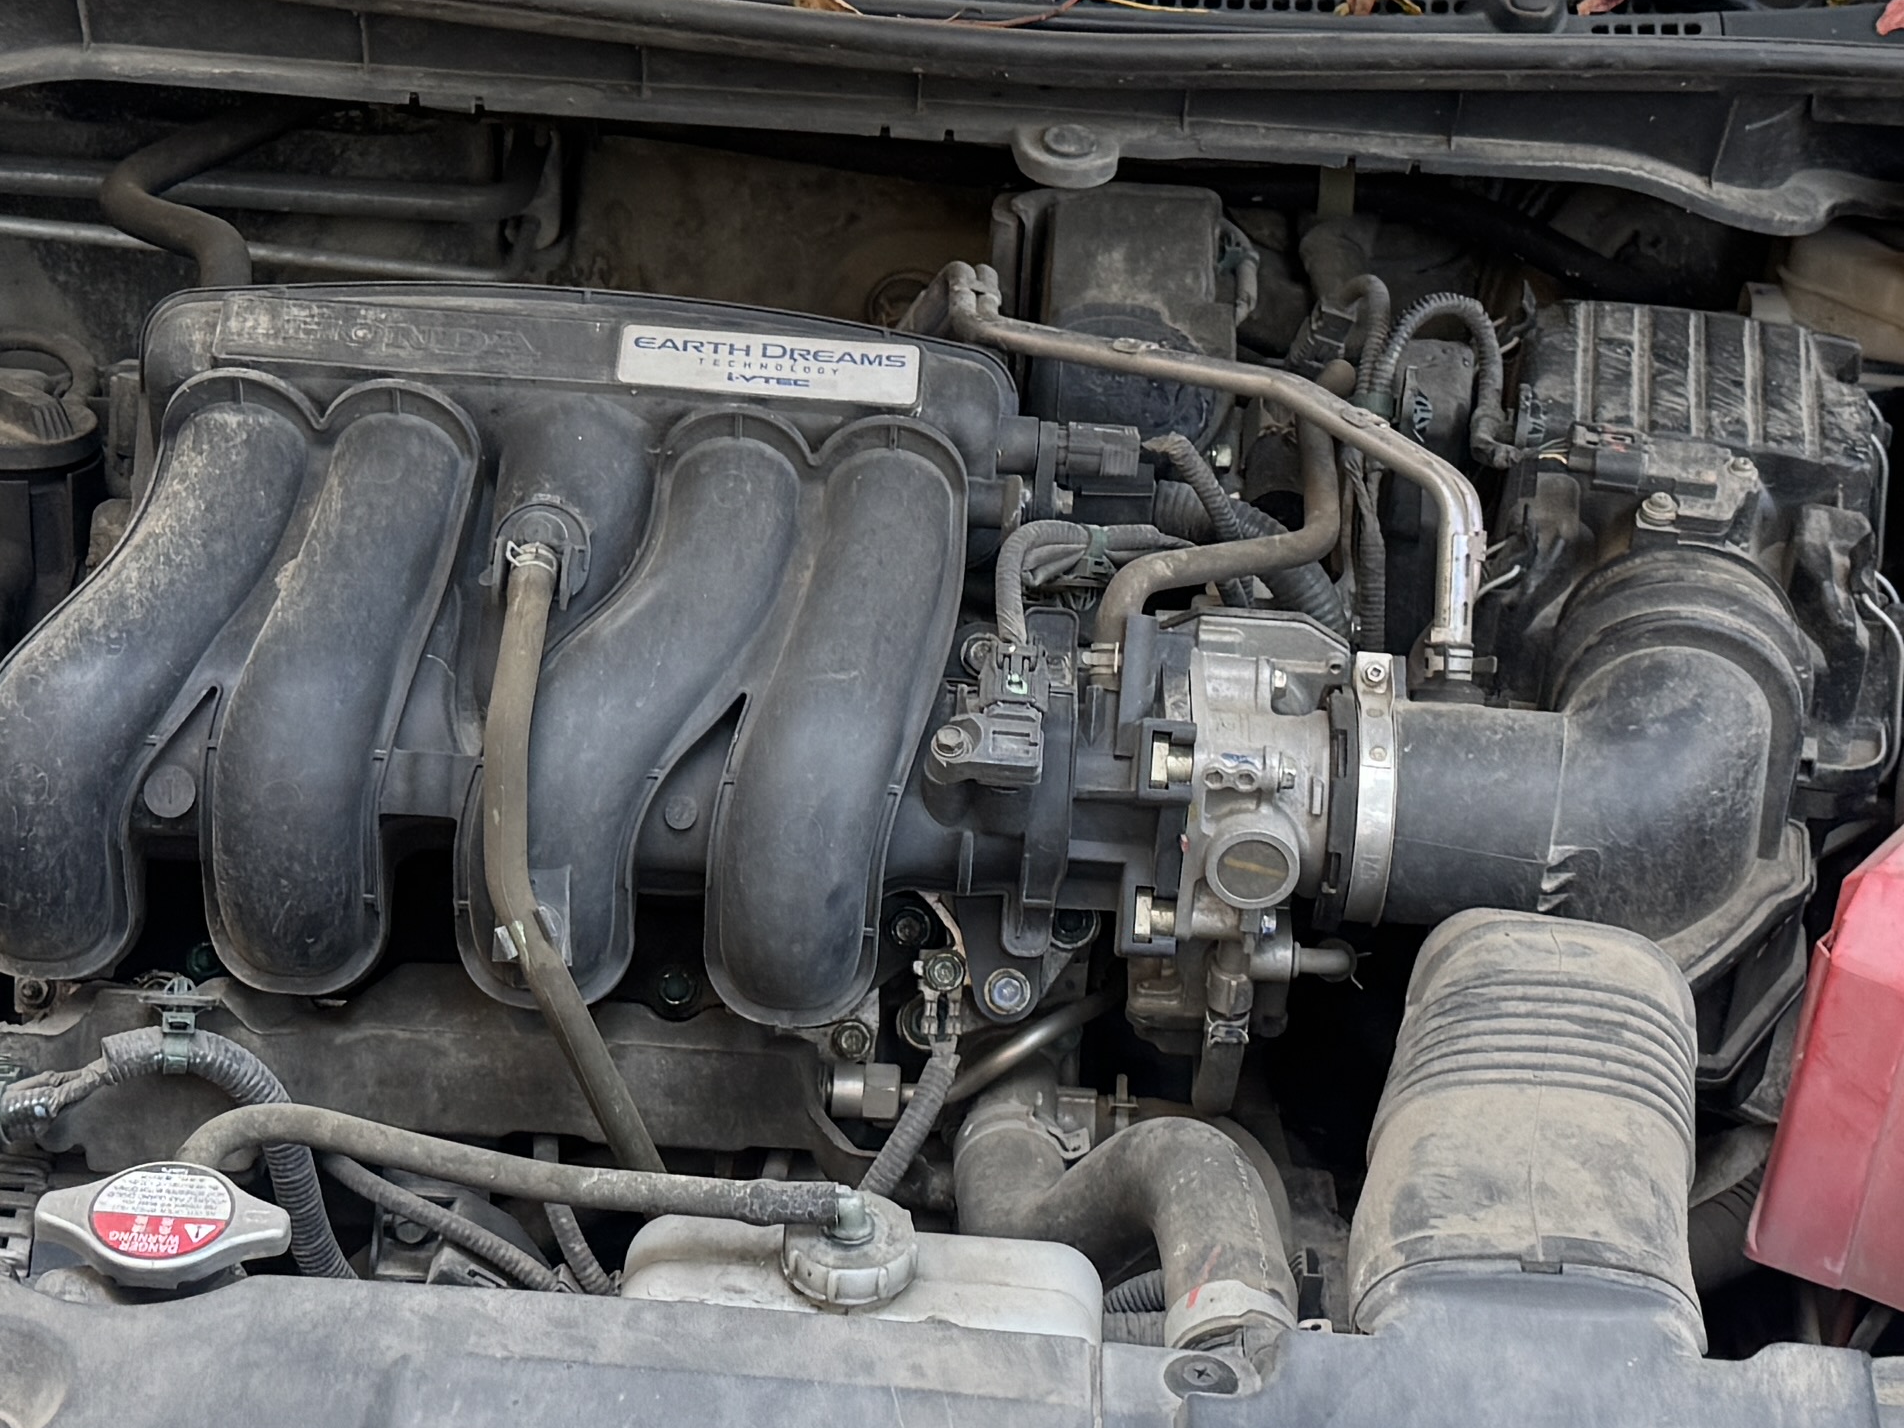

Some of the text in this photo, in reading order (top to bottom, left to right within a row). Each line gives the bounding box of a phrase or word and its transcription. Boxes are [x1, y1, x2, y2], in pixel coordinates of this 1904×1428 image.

[633, 336, 907, 368] EARTH DREAMS
[698, 357, 840, 376] TECHNOLOGY
[118, 1238, 180, 1255] DANGER
